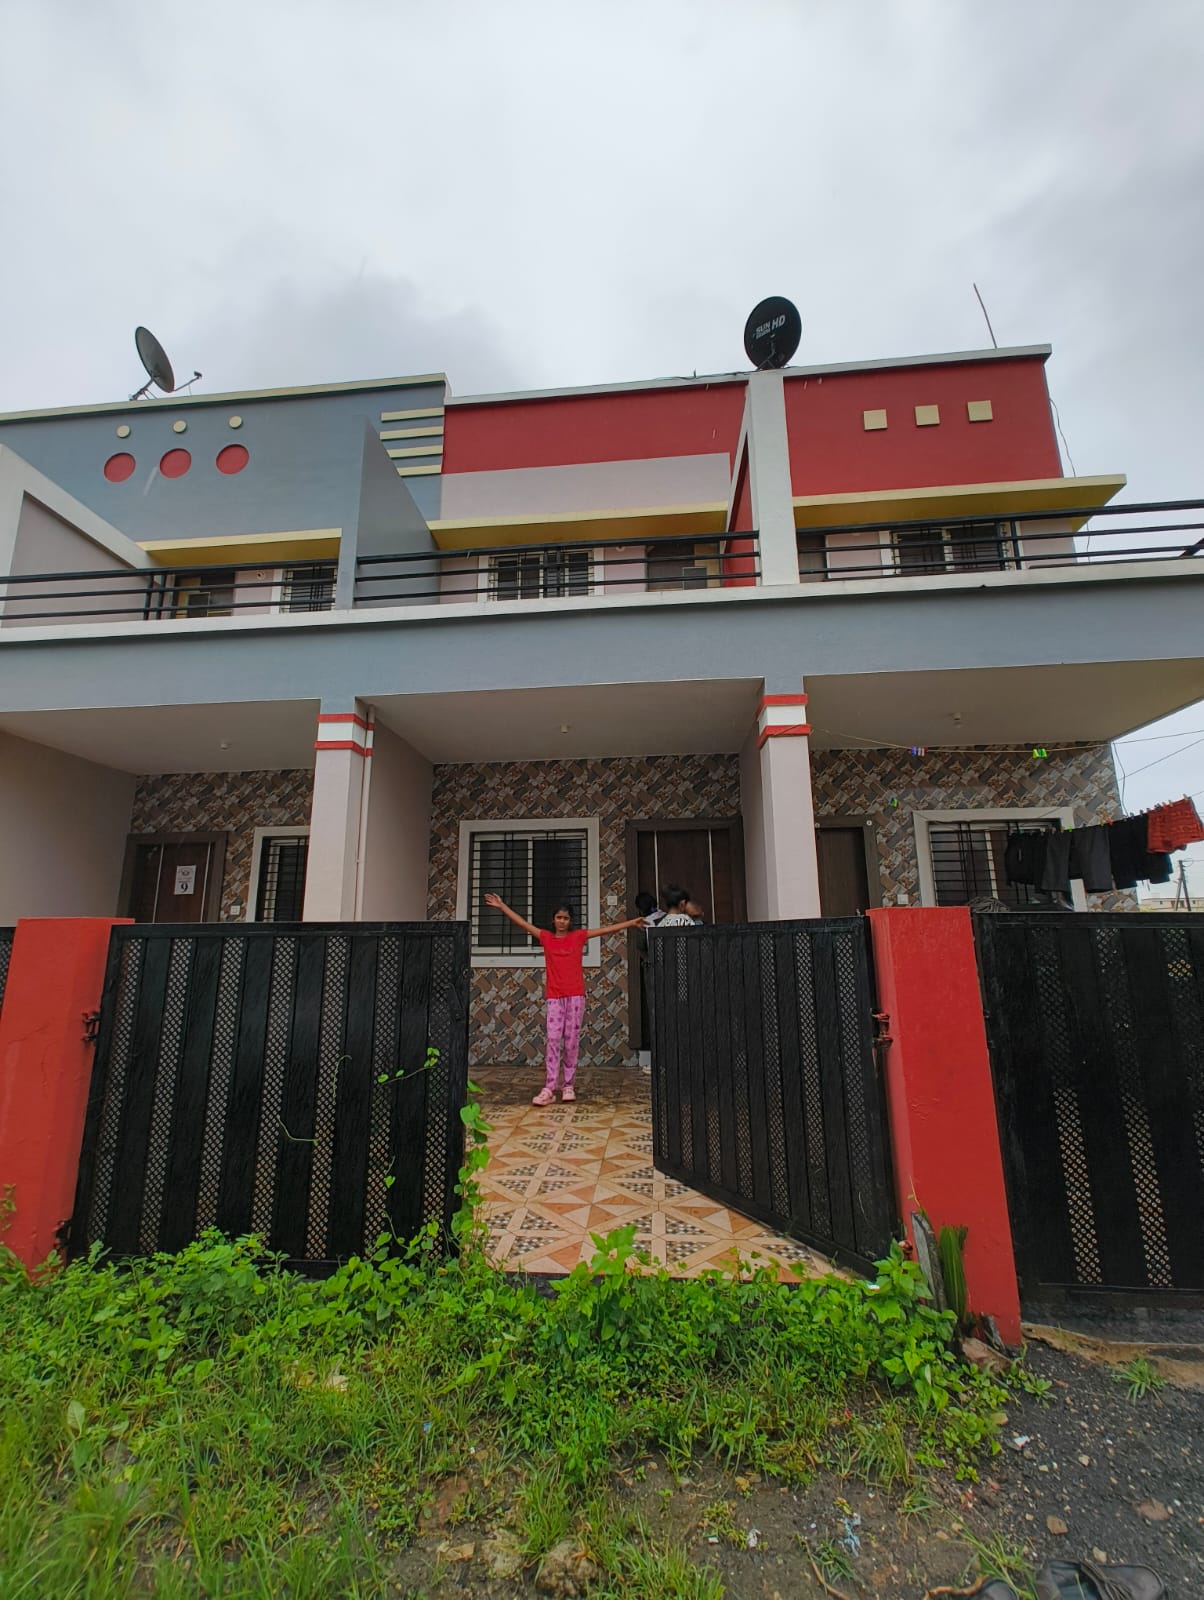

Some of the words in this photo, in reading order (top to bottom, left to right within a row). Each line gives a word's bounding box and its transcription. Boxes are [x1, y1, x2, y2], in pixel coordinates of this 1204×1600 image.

[756, 321, 770, 332] SUN
[772, 315, 785, 330] HD
[181, 882, 188, 893] 9
